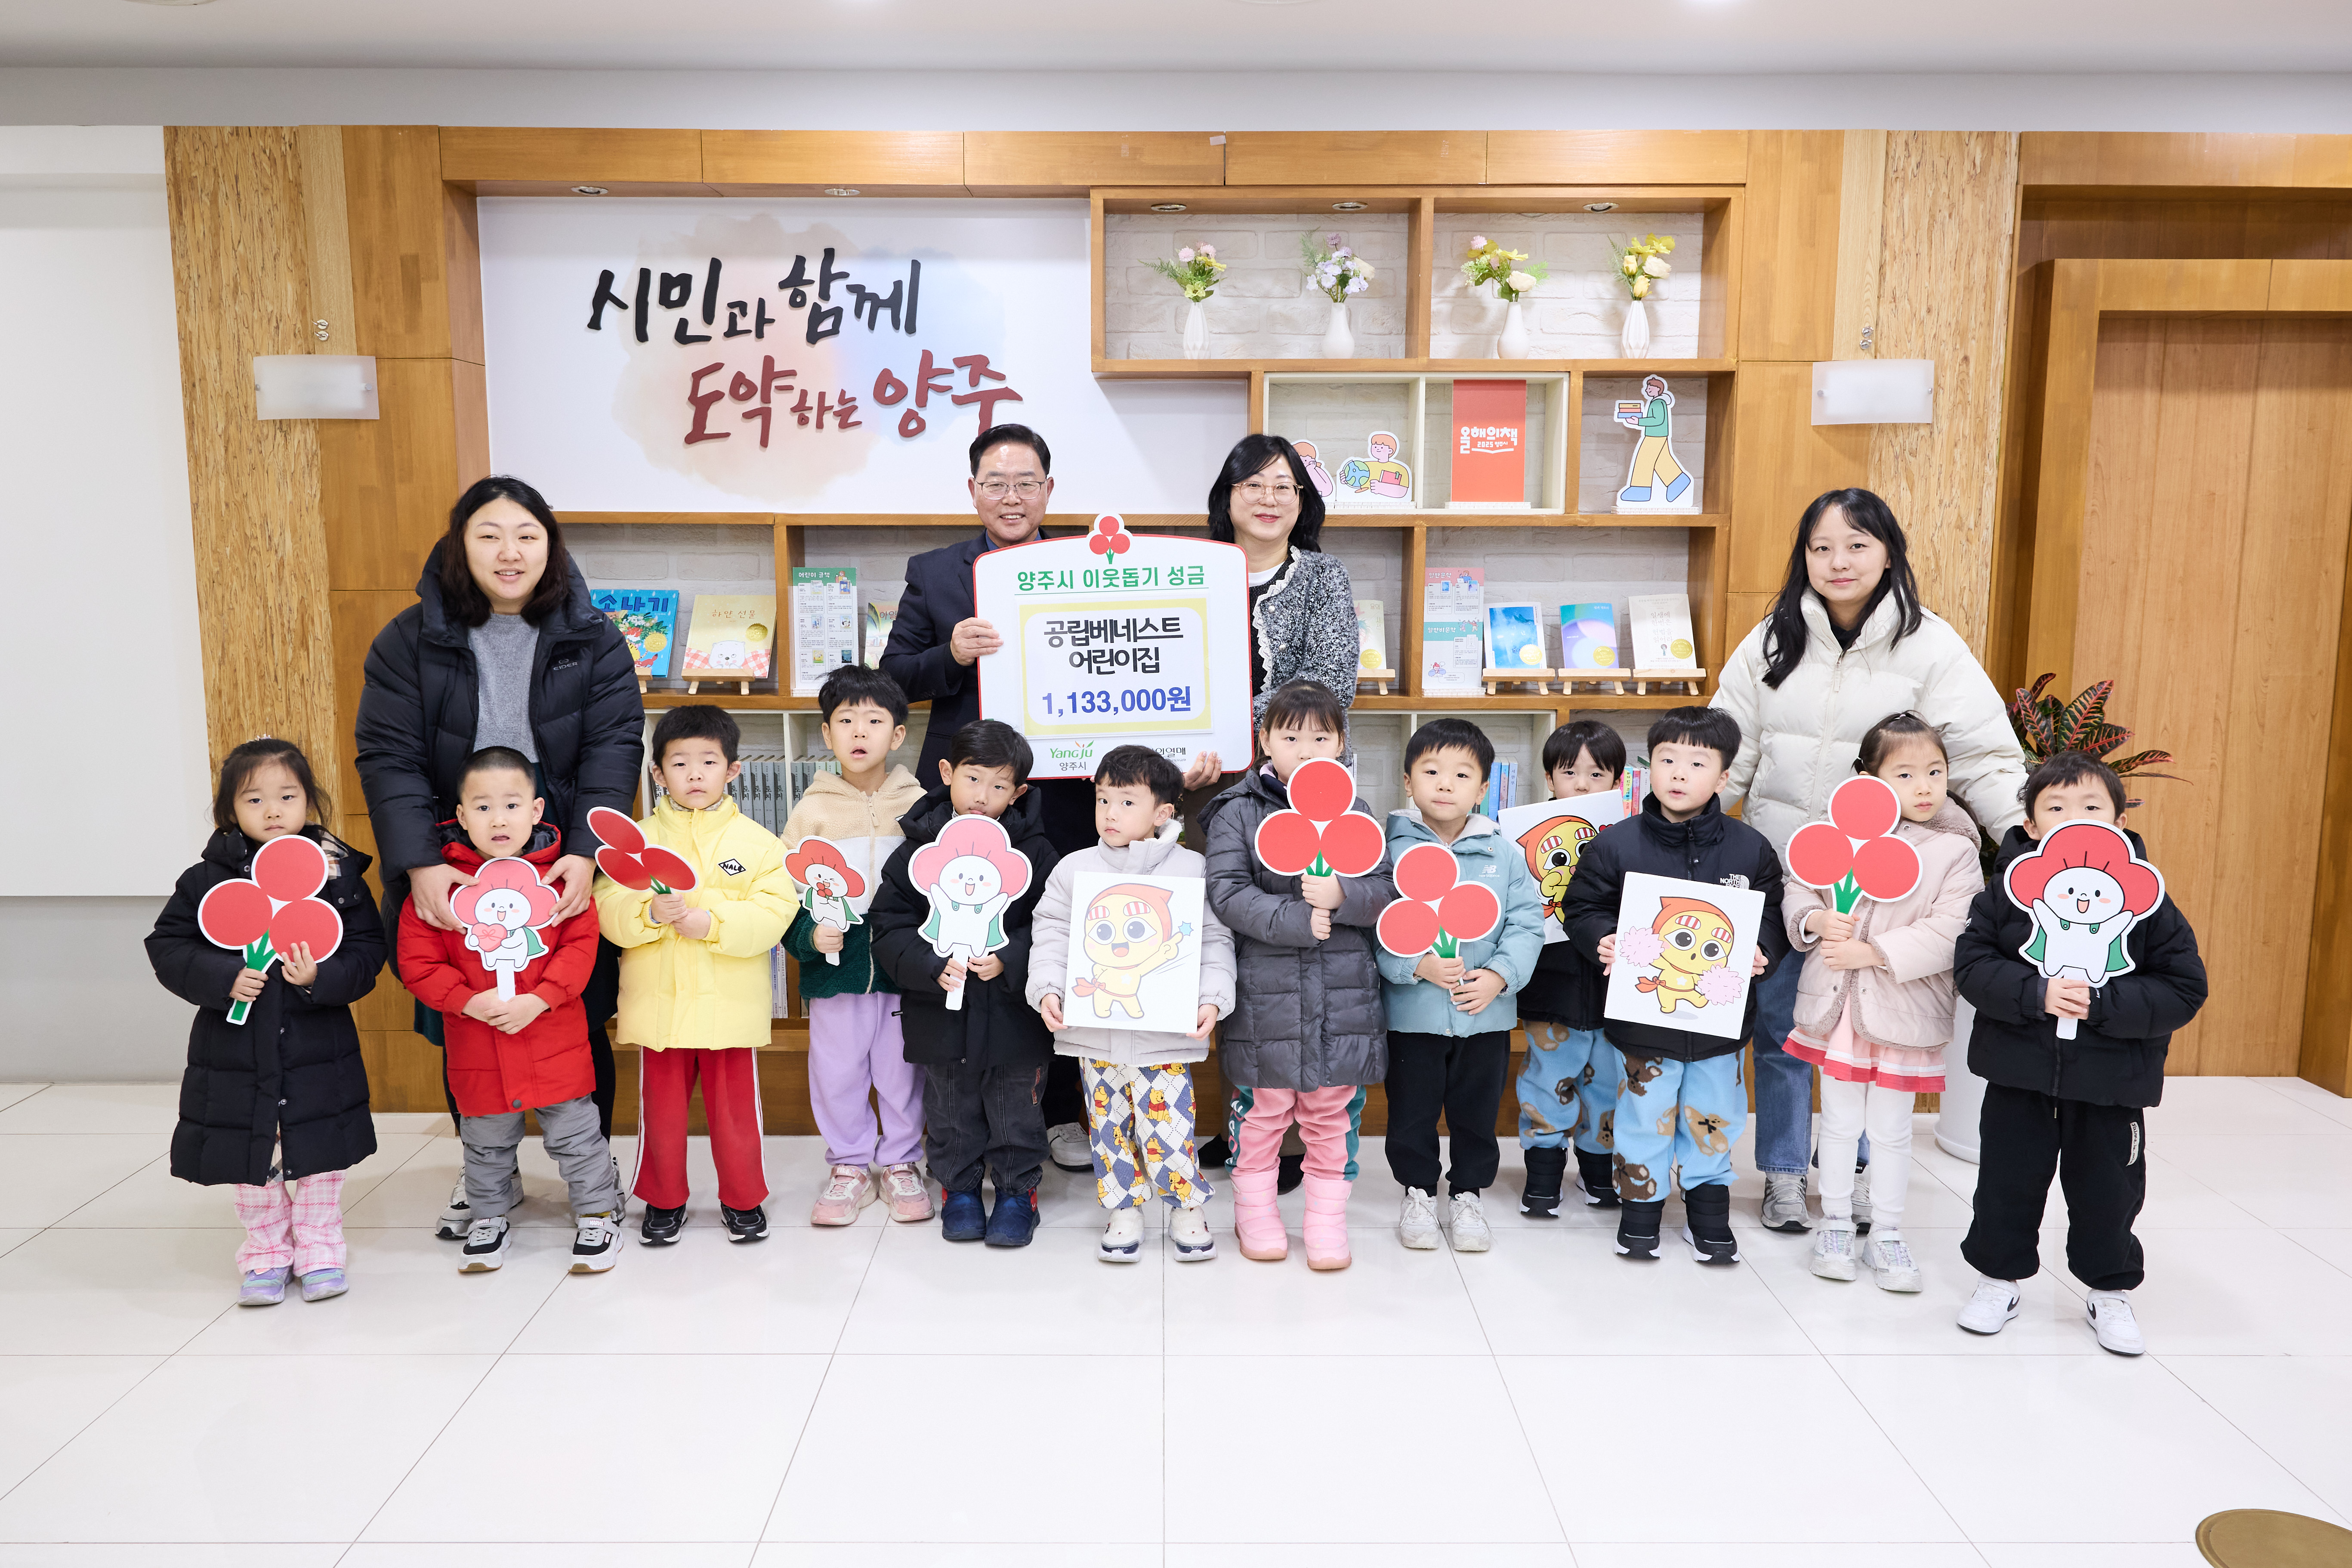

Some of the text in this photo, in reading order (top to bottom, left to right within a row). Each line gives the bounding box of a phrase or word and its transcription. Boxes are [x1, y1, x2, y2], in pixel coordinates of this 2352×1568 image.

[587, 247, 921, 344] 시민과 함께
[684, 349, 1023, 447] 도약하는 양주
[1018, 565, 1205, 591] 양주시 이웃돕기 성금
[599, 595, 668, 612] 소나기
[712, 609, 756, 619] 하얀 선물
[1044, 617, 1183, 648] 공립베네스트
[553, 662, 578, 671] CIDER
[1069, 647, 1160, 675] 어린이집
[1042, 686, 1191, 717] 1,133,000원
[1155, 747, 1186, 758] 의열매
[1059, 761, 1086, 772] 양주시
[732, 785, 738, 801] 토지
[744, 785, 750, 801] 토지
[755, 785, 761, 801] 토지
[766, 785, 772, 801] 토지
[778, 785, 783, 801] 토지
[795, 786, 801, 801] 토지
